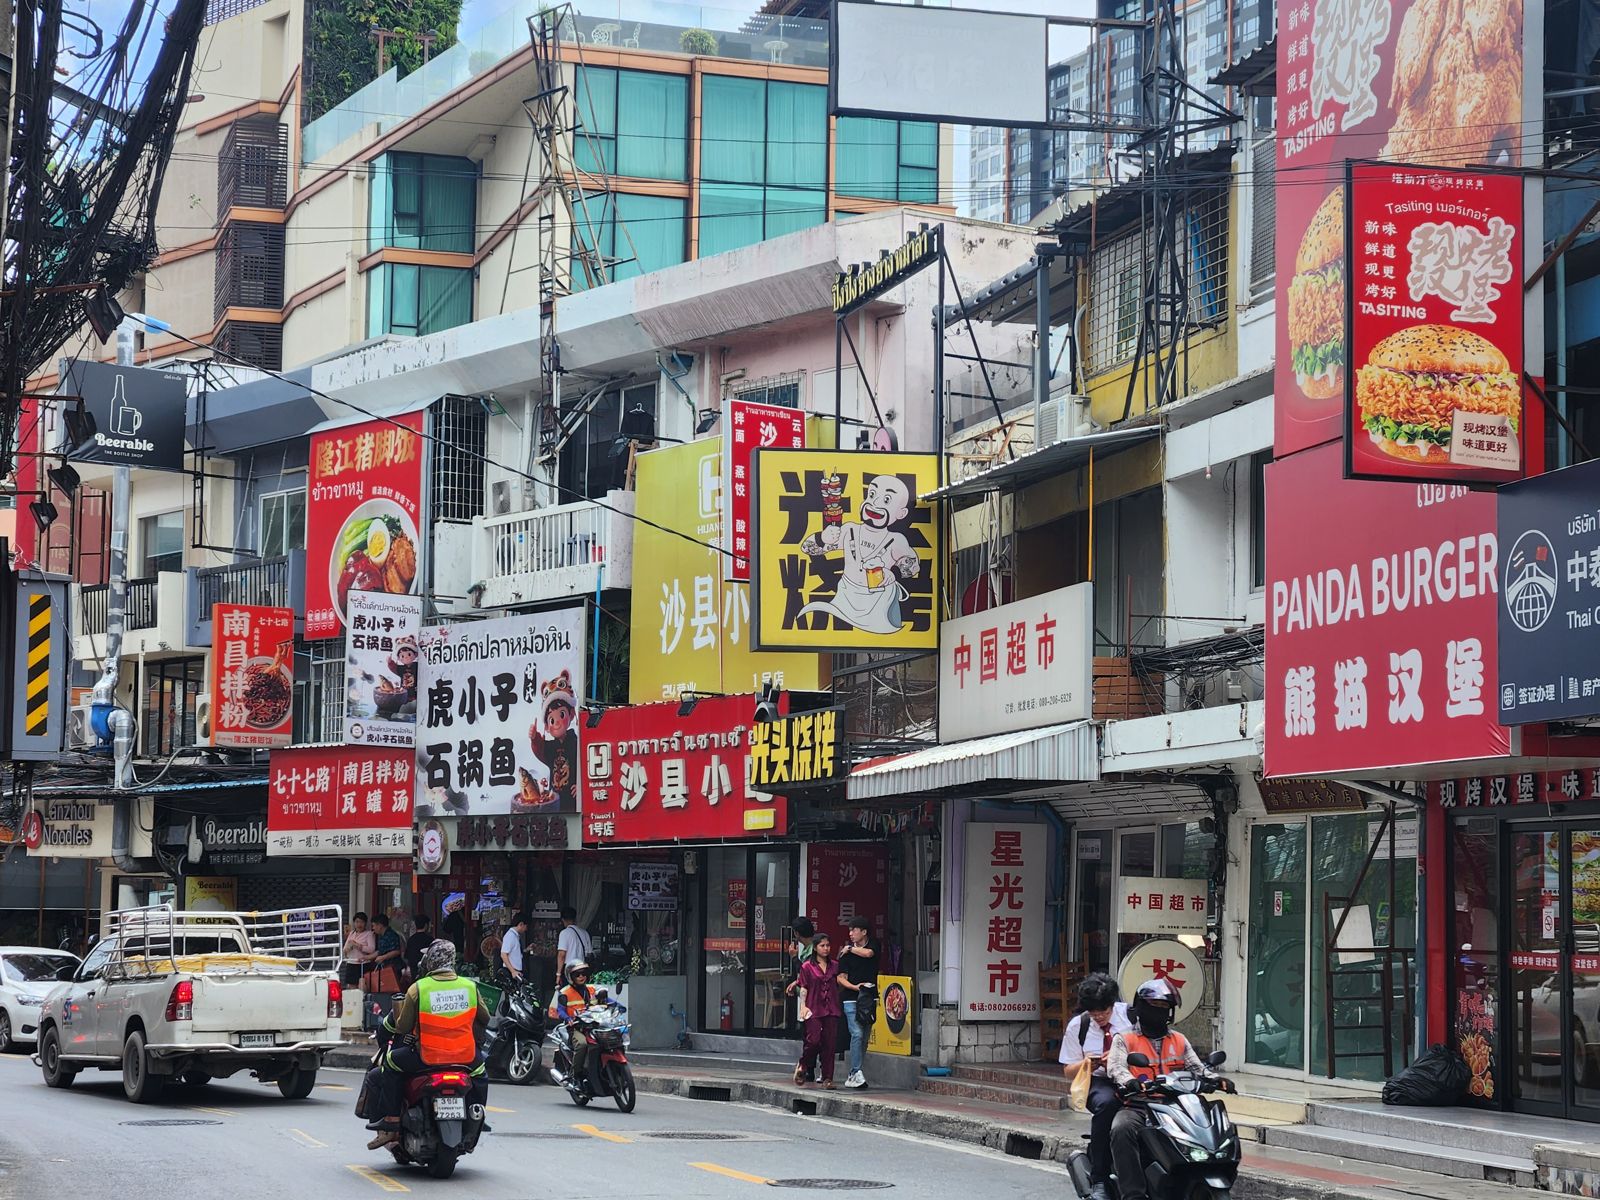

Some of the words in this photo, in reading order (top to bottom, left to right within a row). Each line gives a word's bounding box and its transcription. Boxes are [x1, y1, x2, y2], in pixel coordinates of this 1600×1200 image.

[1283, 112, 1335, 158] TASITING
[1385, 200, 1432, 214] Tasiting
[1359, 302, 1427, 319] TASITING
[760, 421, 778, 447] 沙
[1463, 422, 1508, 437] 现烤汉堡
[95, 433, 154, 451] Beerable
[1462, 438, 1507, 453] 味道更好
[312, 480, 364, 502] ข้าวขาหมู
[1568, 513, 1596, 535] บริษัท
[1273, 564, 1365, 635] PANDA
[1372, 533, 1498, 615] BURGER
[258, 617, 288, 626] 七十七路
[353, 614, 395, 632] 虎小子
[1566, 608, 1592, 629] Thai
[352, 634, 393, 652] 石锅鱼
[426, 626, 570, 665] เสือเด็กปลาหม้อหิน
[954, 612, 1056, 689] 中国超市
[220, 610, 250, 729] 南昌拌粉
[1285, 638, 1484, 738] 熊猫汉堡
[1518, 685, 1555, 705] 签证办理
[426, 672, 518, 729] 虎小子
[751, 710, 836, 785] 光头烧烤
[342, 759, 410, 786] 南昌拌粉
[426, 737, 516, 789] 石锅鱼
[273, 764, 331, 795] 七十七路
[1440, 774, 1535, 807] 现烤汉堡
[43, 800, 95, 821] Lanzhou
[341, 789, 408, 814] 瓦罐汤
[43, 824, 92, 845] Noodles
[205, 821, 268, 845] Beerable
[588, 821, 615, 836] 1号店
[1127, 893, 1205, 911] 中国超市
[987, 831, 1024, 997] 星光超市
